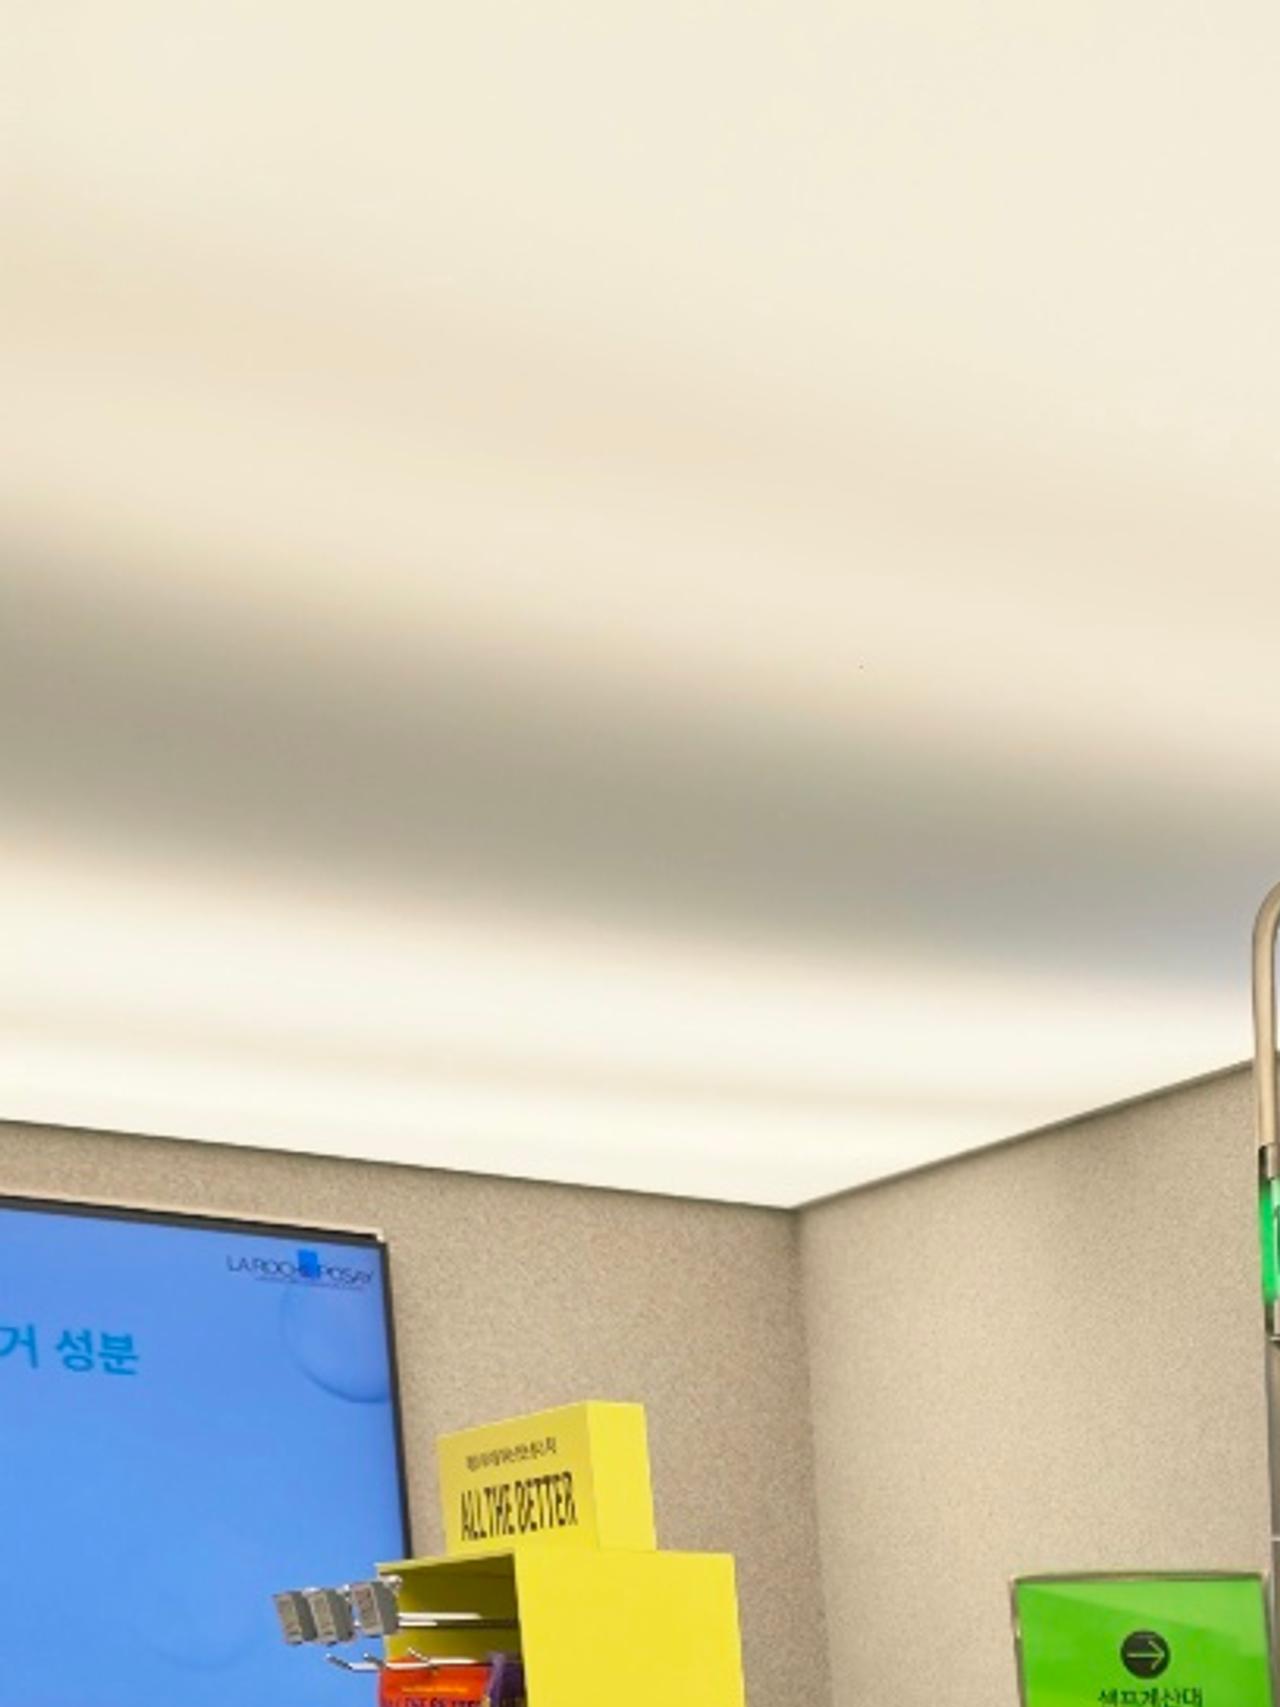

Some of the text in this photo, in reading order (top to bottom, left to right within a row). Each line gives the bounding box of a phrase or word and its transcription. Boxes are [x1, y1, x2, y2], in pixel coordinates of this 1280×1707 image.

[56, 1329, 139, 1376] 성분
[461, 1471, 578, 1541] ALL THE BETTER
